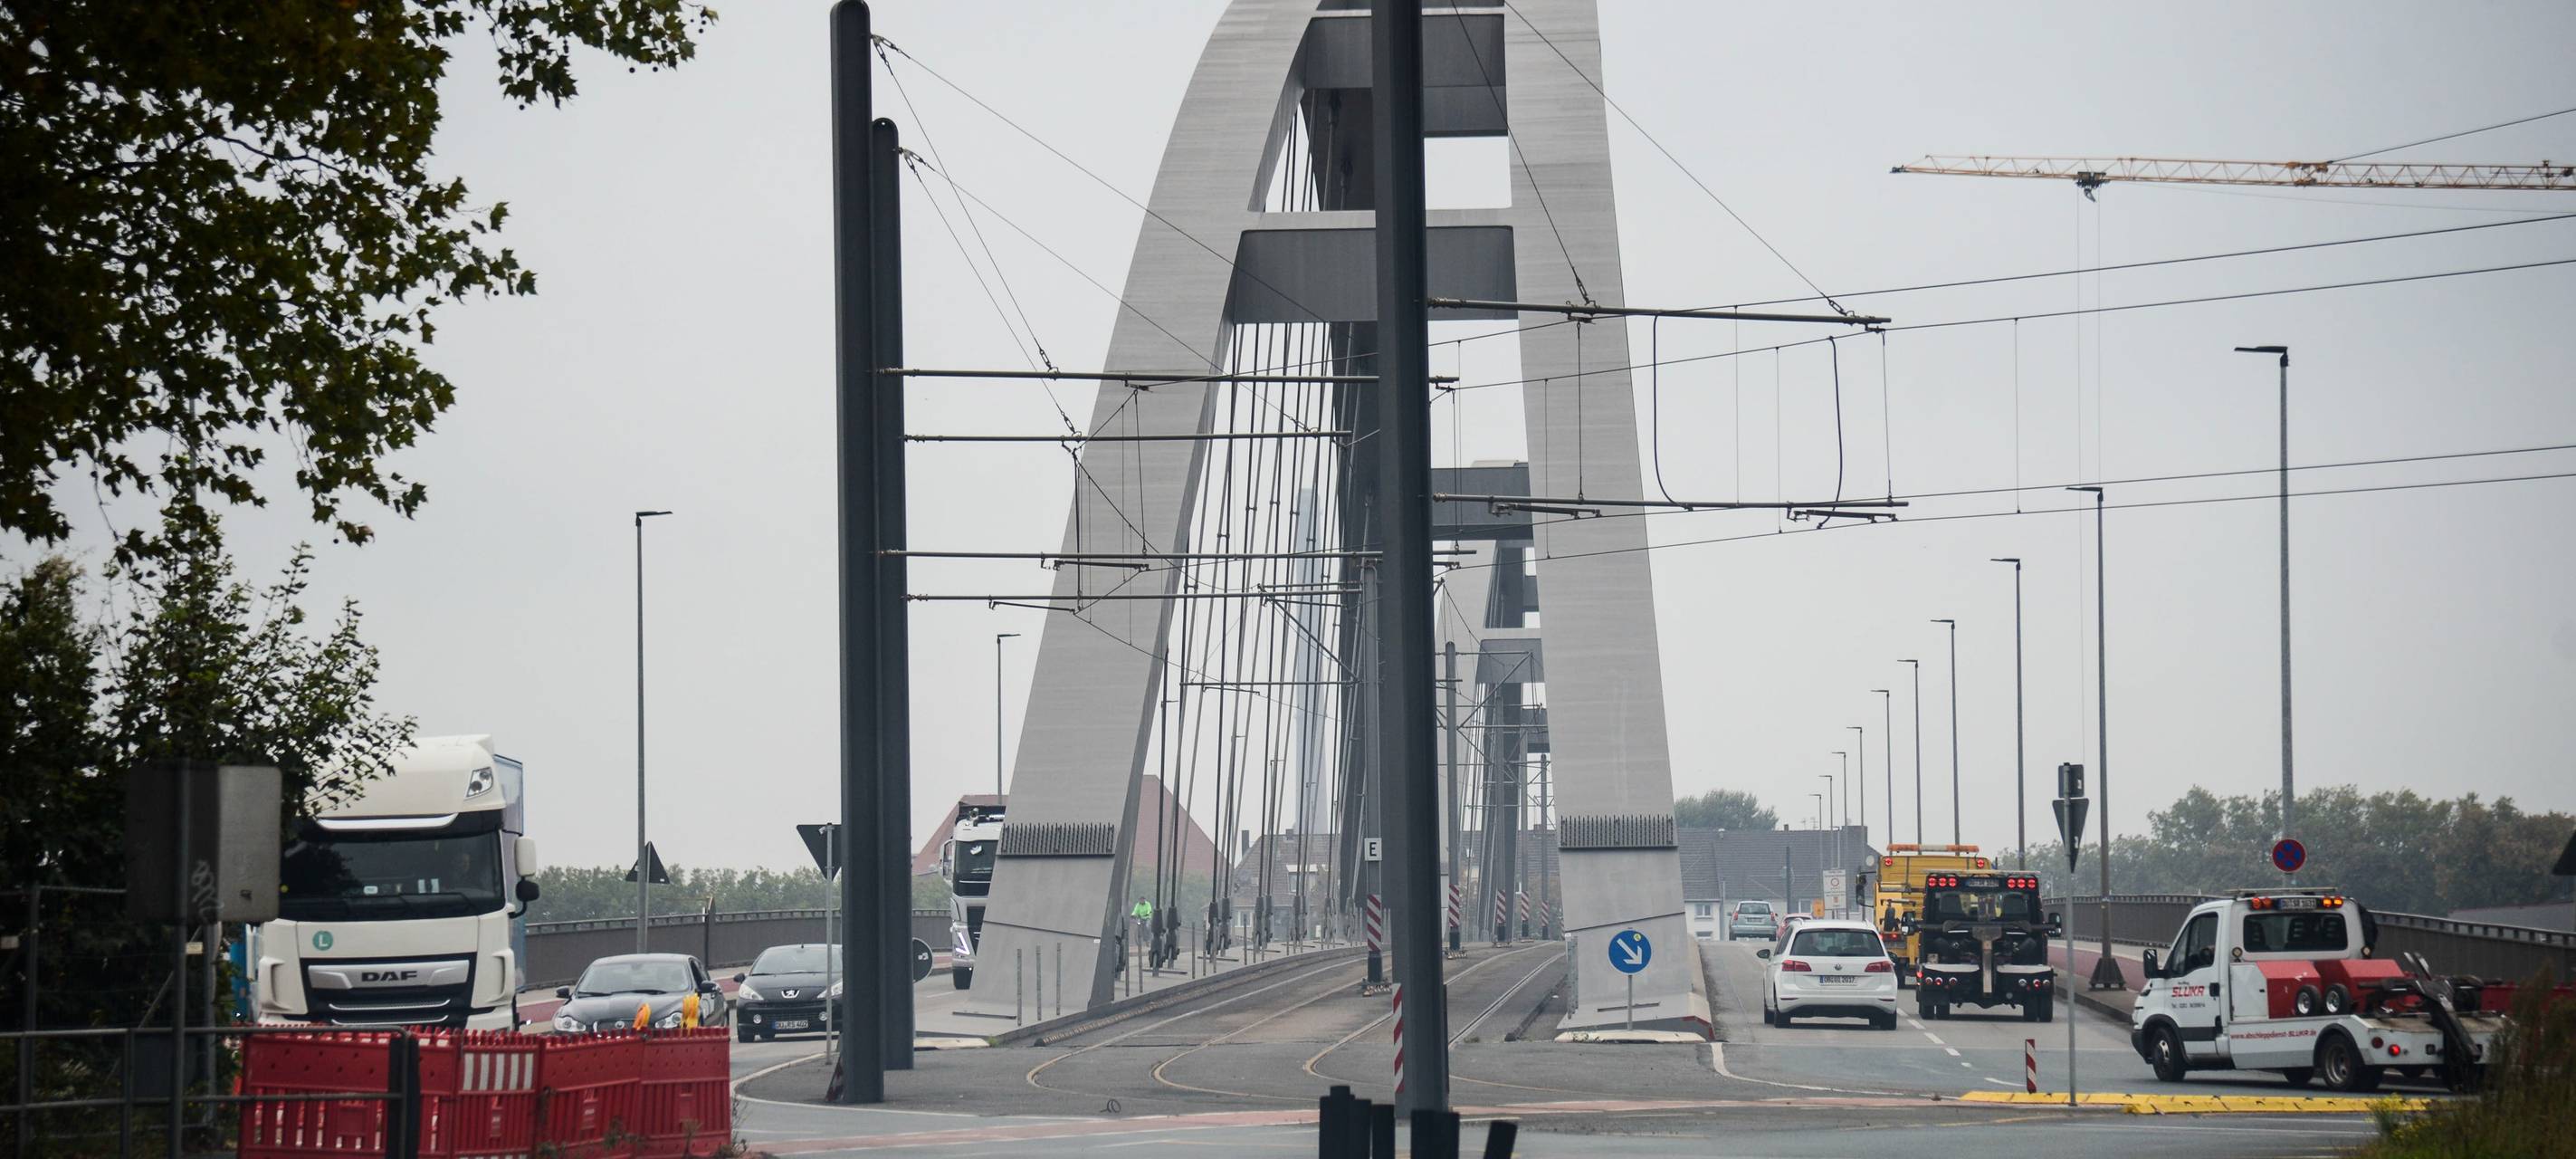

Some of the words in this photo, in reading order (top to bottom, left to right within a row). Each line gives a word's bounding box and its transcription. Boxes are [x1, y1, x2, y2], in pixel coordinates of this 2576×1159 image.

[1369, 842, 1377, 857] E
[319, 934, 329, 947] L
[362, 970, 417, 982] DAF
